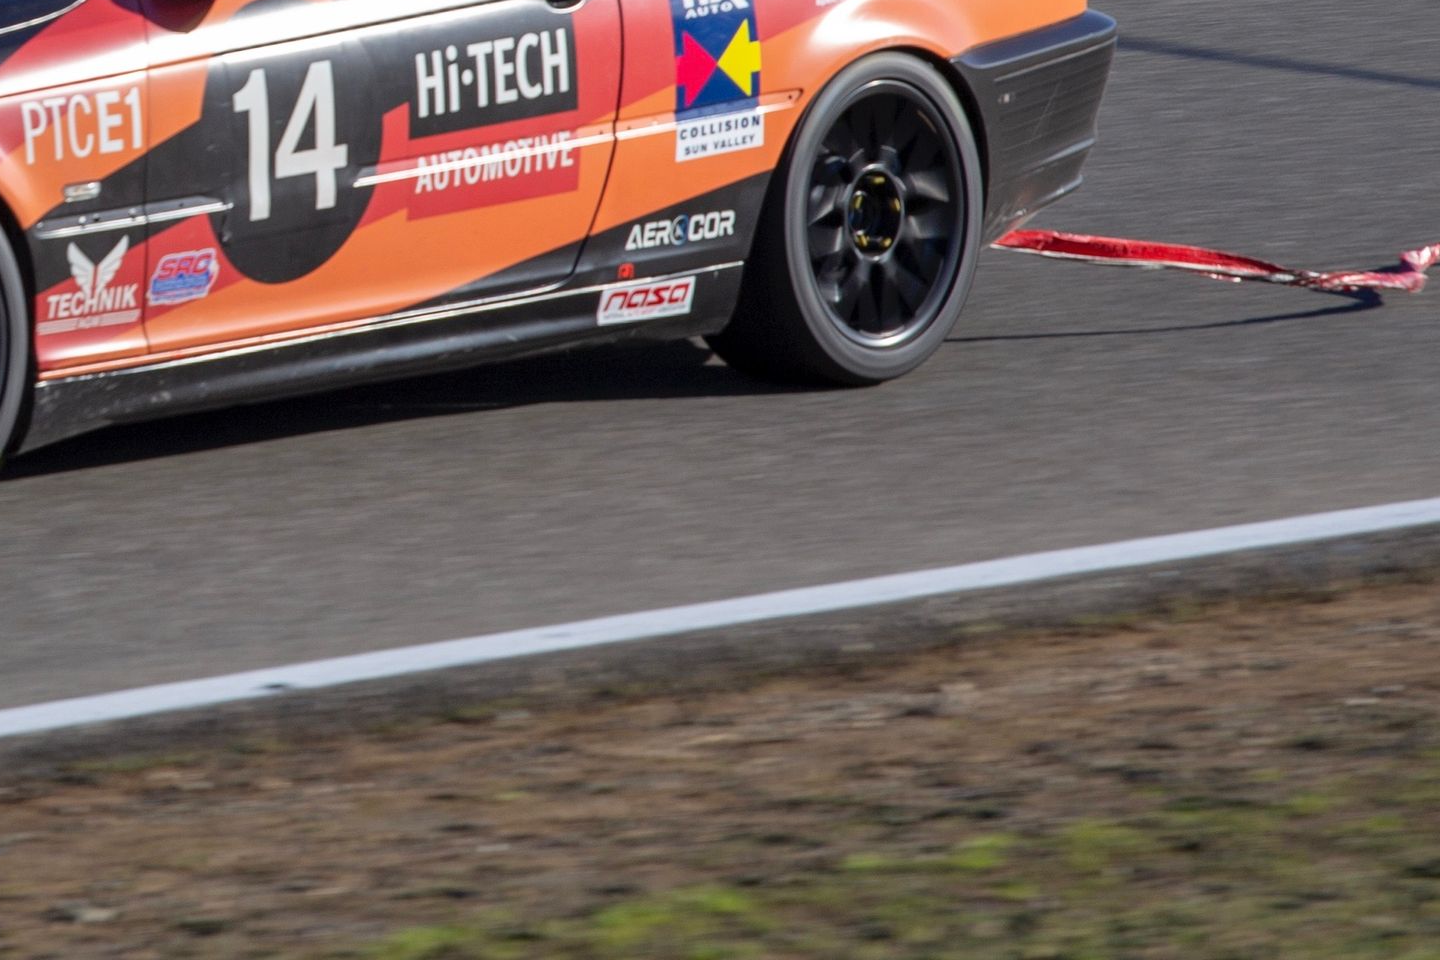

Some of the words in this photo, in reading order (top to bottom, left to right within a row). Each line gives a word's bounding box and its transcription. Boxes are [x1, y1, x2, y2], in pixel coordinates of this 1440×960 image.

[685, 1, 734, 19] AUTO
[20, 87, 143, 165] PTCE1
[233, 60, 348, 222] 14
[680, 115, 760, 140] COLLISION
[415, 131, 574, 194] AUTOMOTIVE
[684, 144, 707, 155] SUN
[713, 134, 755, 149] VALLEY
[46, 283, 139, 319] TECHNIK
